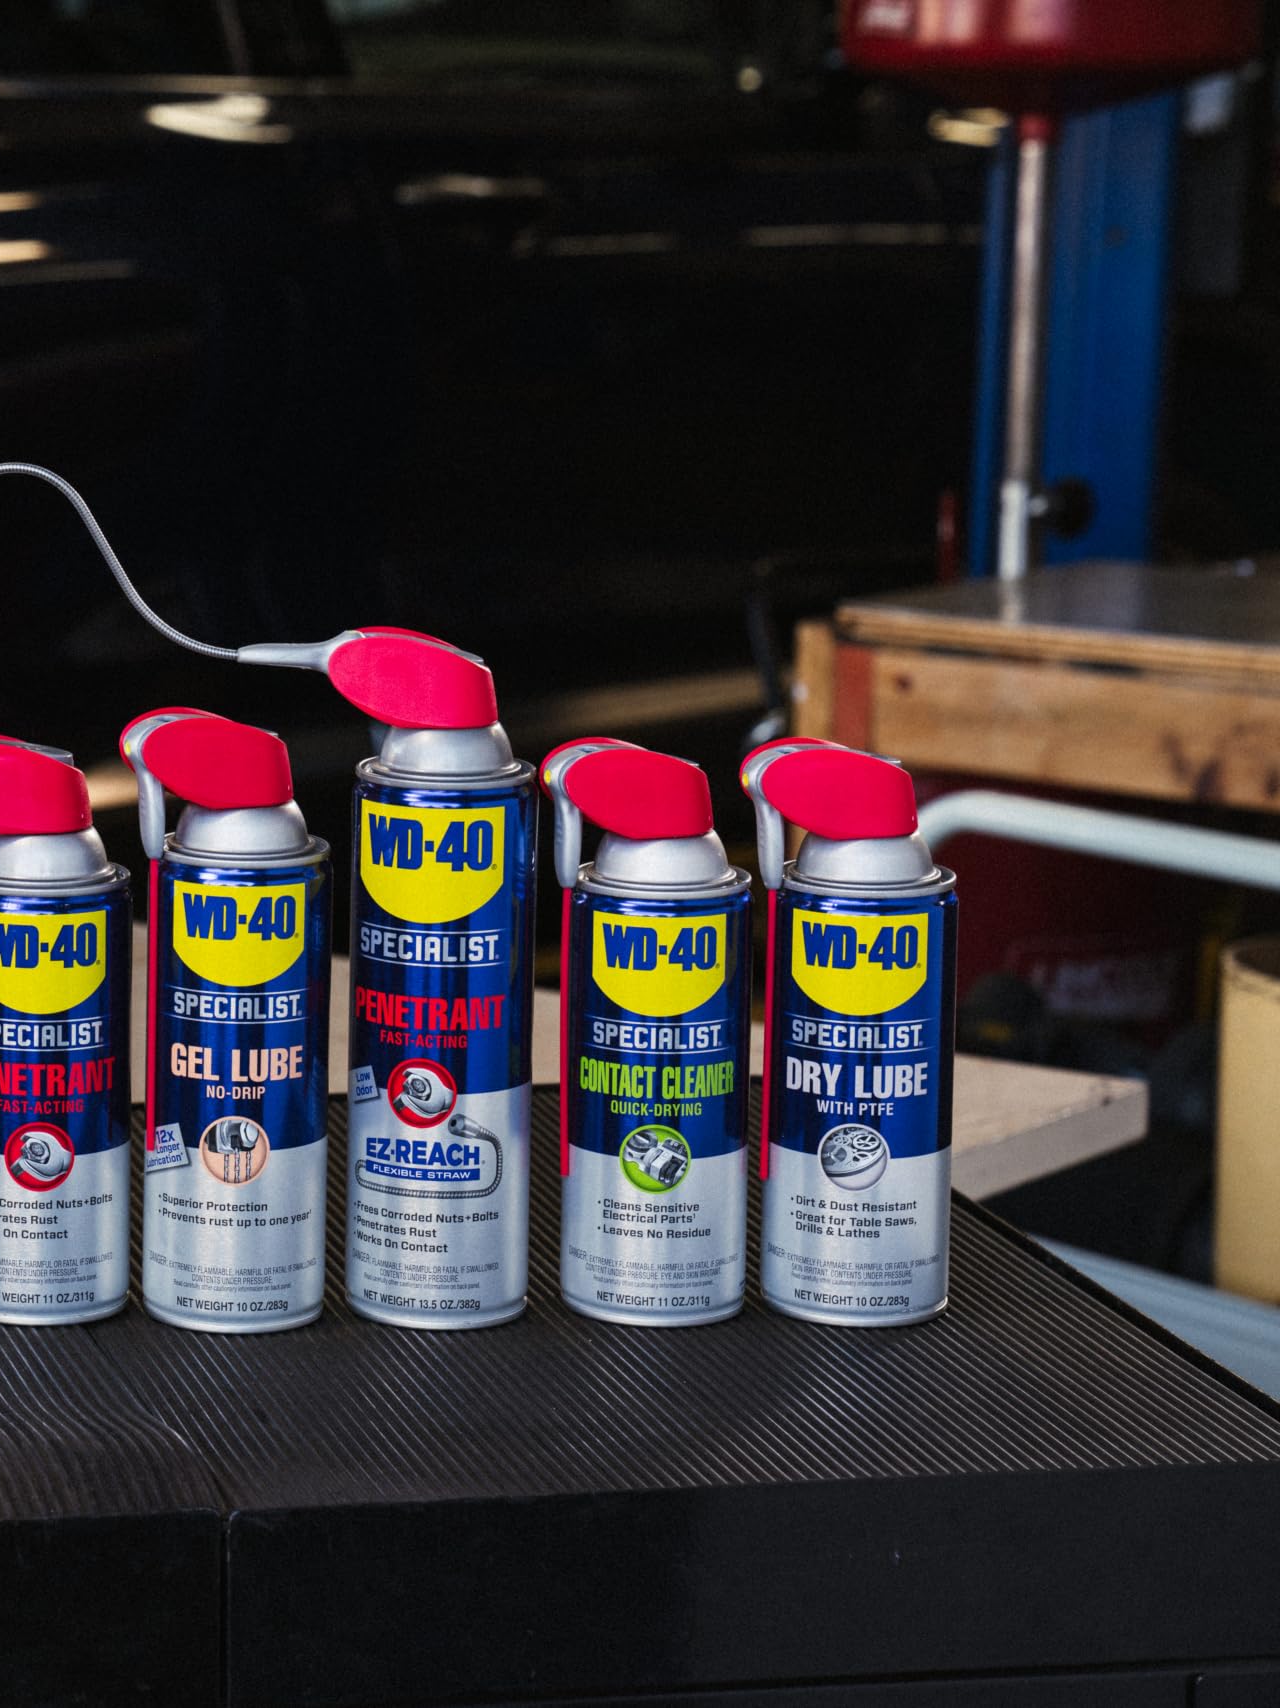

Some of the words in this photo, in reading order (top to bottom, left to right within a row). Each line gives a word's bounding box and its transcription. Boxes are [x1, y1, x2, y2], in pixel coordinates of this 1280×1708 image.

[369, 813, 494, 872] WD-40
[183, 893, 296, 941] WD-40
[360, 927, 499, 962] SPECIALIST
[602, 923, 717, 971] WD-40
[802, 921, 918, 970] WD-40
[174, 991, 301, 1019] SPECIALIST
[355, 986, 506, 1031] PENETRANT
[380, 1030, 468, 1049] FAST-ACTING
[593, 1021, 721, 1050] SPECIALIST
[792, 1019, 922, 1049] SPECIALIST
[171, 1042, 219, 1081] GEL
[231, 1045, 303, 1083] LUBE
[355, 1070, 371, 1082] Low
[580, 1056, 656, 1099] CONTACT
[662, 1061, 734, 1099] CLEANER
[786, 1056, 842, 1097] DRY
[854, 1062, 928, 1099] LUBE
[206, 1085, 266, 1100] NO-DRIP
[355, 1084, 373, 1096] Odor
[610, 1100, 702, 1117] QUICK-DRYING
[817, 1099, 853, 1115] WITH
[859, 1102, 894, 1116] PTFE
[156, 1130, 175, 1144] 12x
[156, 1143, 180, 1153] Longer
[372, 1165, 422, 1178] FLEXIBLE
[428, 1171, 471, 1180] STRAW
[0, 1198, 53, 1210] Corroded
[56, 1193, 113, 1209] Nuts+Bolts
[162, 1193, 203, 1209] Superior
[206, 1201, 268, 1212] Protection
[603, 1199, 641, 1212] Cleans
[645, 1203, 700, 1213] Sensitive
[796, 1195, 815, 1208] Dirt
[818, 1200, 826, 1209] &
[830, 1201, 858, 1211] Dust
[862, 1200, 917, 1211] Resistant
[30, 1215, 58, 1225] Rust
[162, 1208, 206, 1225] Prevents
[209, 1216, 233, 1227] rust
[237, 1218, 251, 1228] up
[255, 1217, 266, 1226] to
[269, 1216, 288, 1226] one
[357, 1200, 378, 1215] Frees
[381, 1208, 432, 1222] Corroded
[436, 1210, 499, 1223] Nuts+Bolts
[603, 1210, 657, 1223] Electrical
[796, 1210, 826, 1224] Great
[829, 1215, 846, 1226] for
[850, 1217, 882, 1227] Table
[885, 1217, 917, 1227] Saws,
[3, 1229, 18, 1238] On
[21, 1230, 68, 1239] Contact
[357, 1216, 406, 1235] Penetrates
[409, 1227, 437, 1237] Rust
[603, 1224, 643, 1238] Leaves
[647, 1229, 663, 1239] No
[667, 1228, 711, 1239] Residue
[795, 1222, 823, 1234] Drills
[826, 1227, 834, 1236] &
[838, 1228, 880, 1238] Lathes
[357, 1230, 382, 1245] Works
[385, 1238, 398, 1249] On
[401, 1240, 449, 1253] Contact
[2, 1291, 40, 1304] WEIGHT
[44, 1294, 53, 1303] 11
[56, 1291, 95, 1304] OZ./311g
[177, 1296, 193, 1307] NET
[196, 1298, 233, 1311] WEIGHT
[237, 1302, 248, 1312] 10
[250, 1300, 288, 1312] OZ./283g
[364, 1289, 377, 1300] NET
[380, 1294, 416, 1308] WEIGHT
[420, 1300, 437, 1310] 13.5
[440, 1299, 480, 1310] OZ./382g
[597, 1290, 614, 1302] NET
[616, 1293, 655, 1306] WEIGHT
[659, 1297, 668, 1306] 11
[671, 1295, 710, 1307] OZ./311g
[794, 1288, 811, 1299] NET
[813, 1293, 853, 1306] WEIGHT
[856, 1297, 866, 1306] 10
[870, 1296, 910, 1306] OZ./283g
